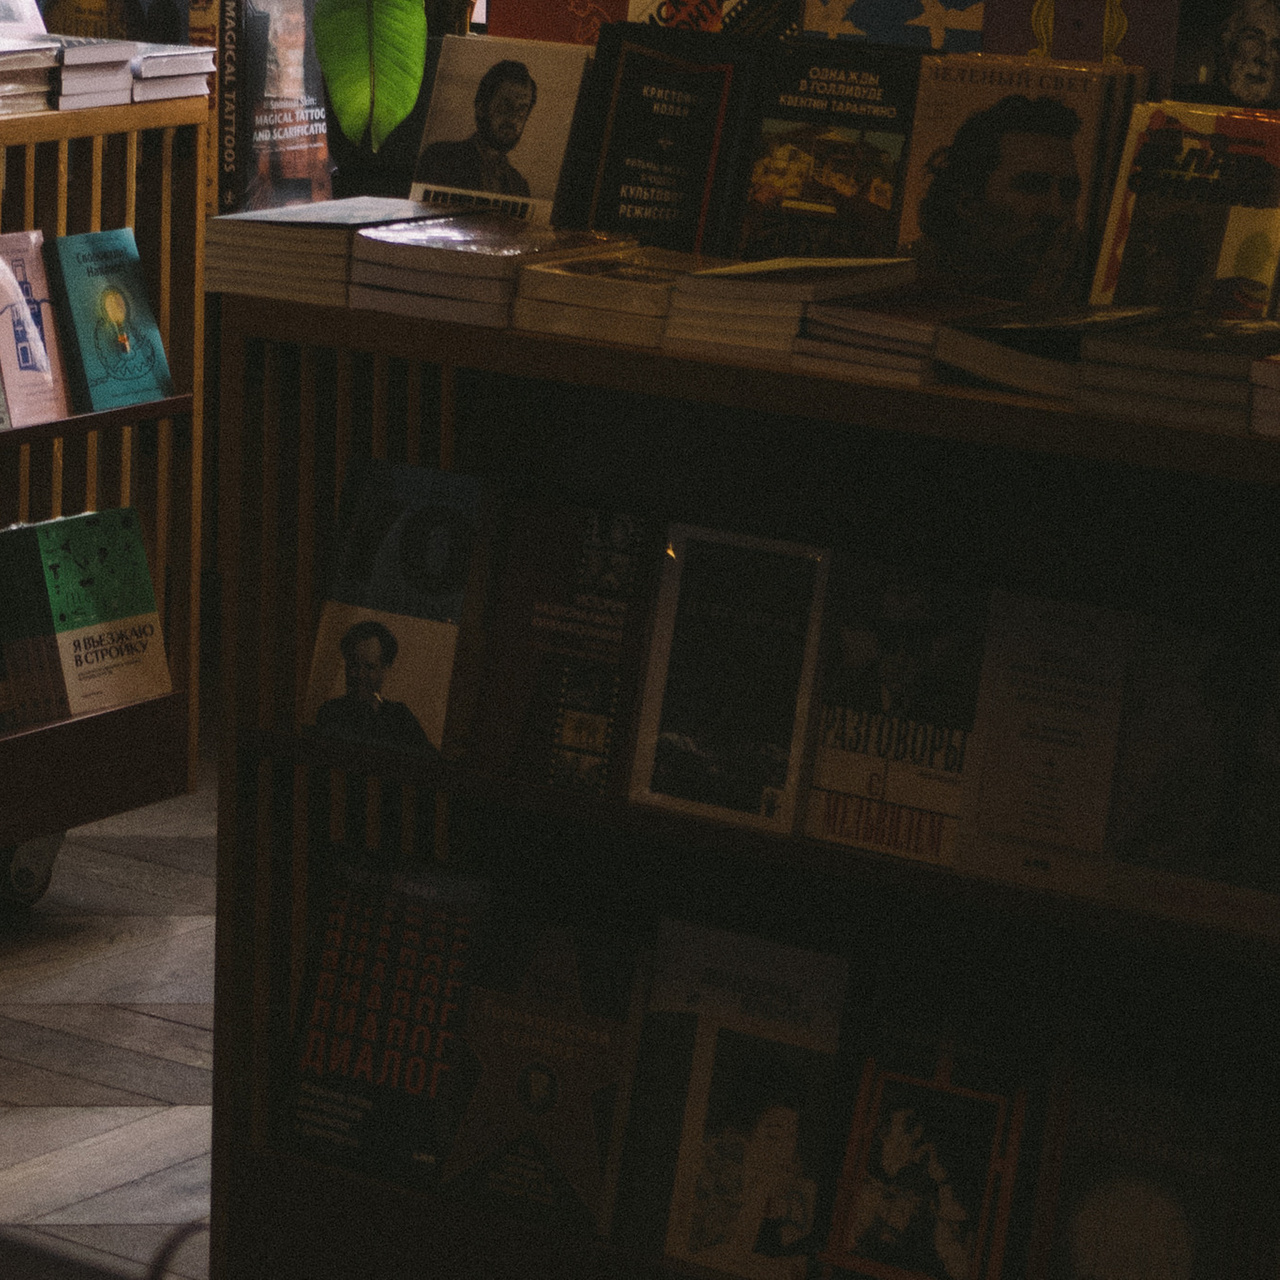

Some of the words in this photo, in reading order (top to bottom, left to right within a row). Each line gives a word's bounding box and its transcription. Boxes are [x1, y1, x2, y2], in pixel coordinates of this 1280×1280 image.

[223, 0, 237, 86] MAGICAL
[255, 113, 294, 126] MAGICAL
[223, 91, 237, 173] TATTOOS
[252, 129, 272, 142] AND
[72, 638, 82, 654] Я
[74, 653, 83, 668] В
[83, 640, 149, 666] СТРОЙКУ
